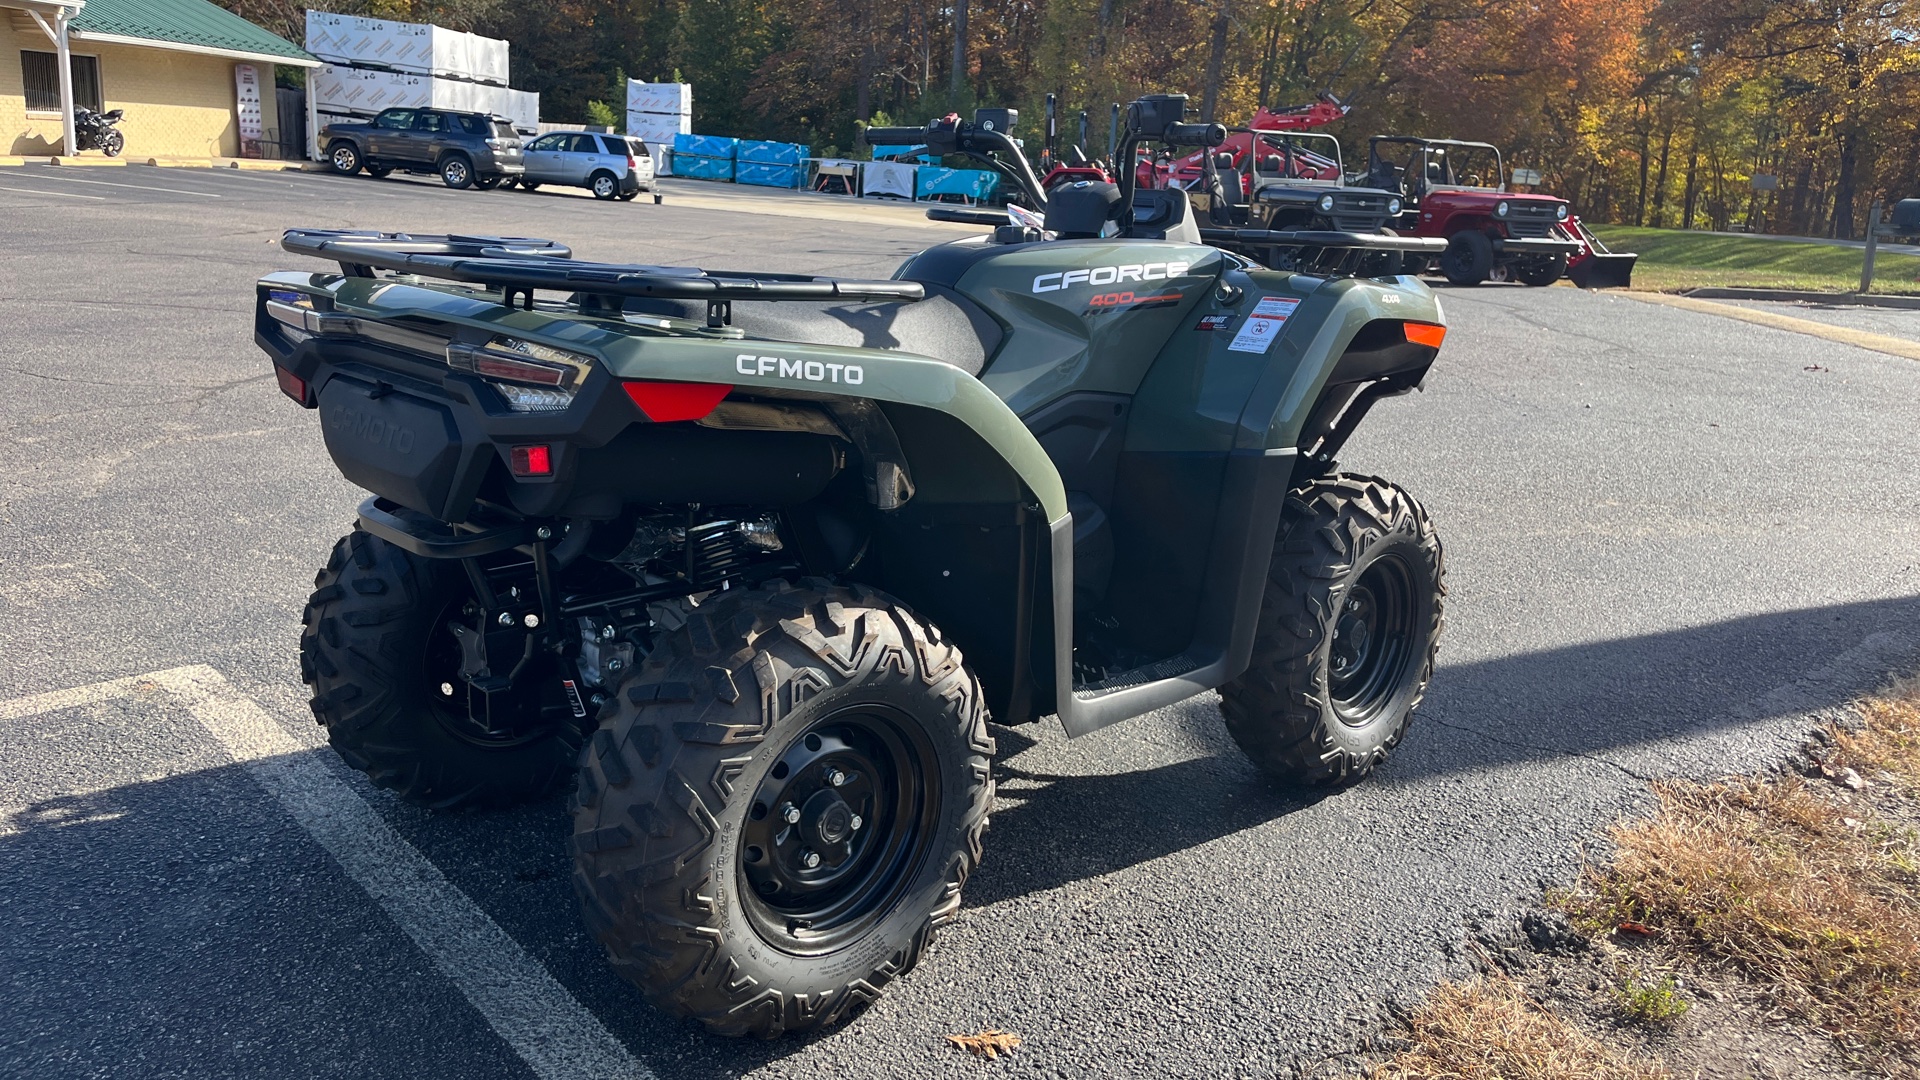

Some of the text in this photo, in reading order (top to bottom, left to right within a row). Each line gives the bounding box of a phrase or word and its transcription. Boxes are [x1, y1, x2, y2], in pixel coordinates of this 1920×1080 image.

[1032, 261, 1189, 294] CFORCE
[1089, 291, 1134, 306] 400
[736, 354, 864, 385] CFMOTO
[331, 404, 416, 455] CFMOTO
